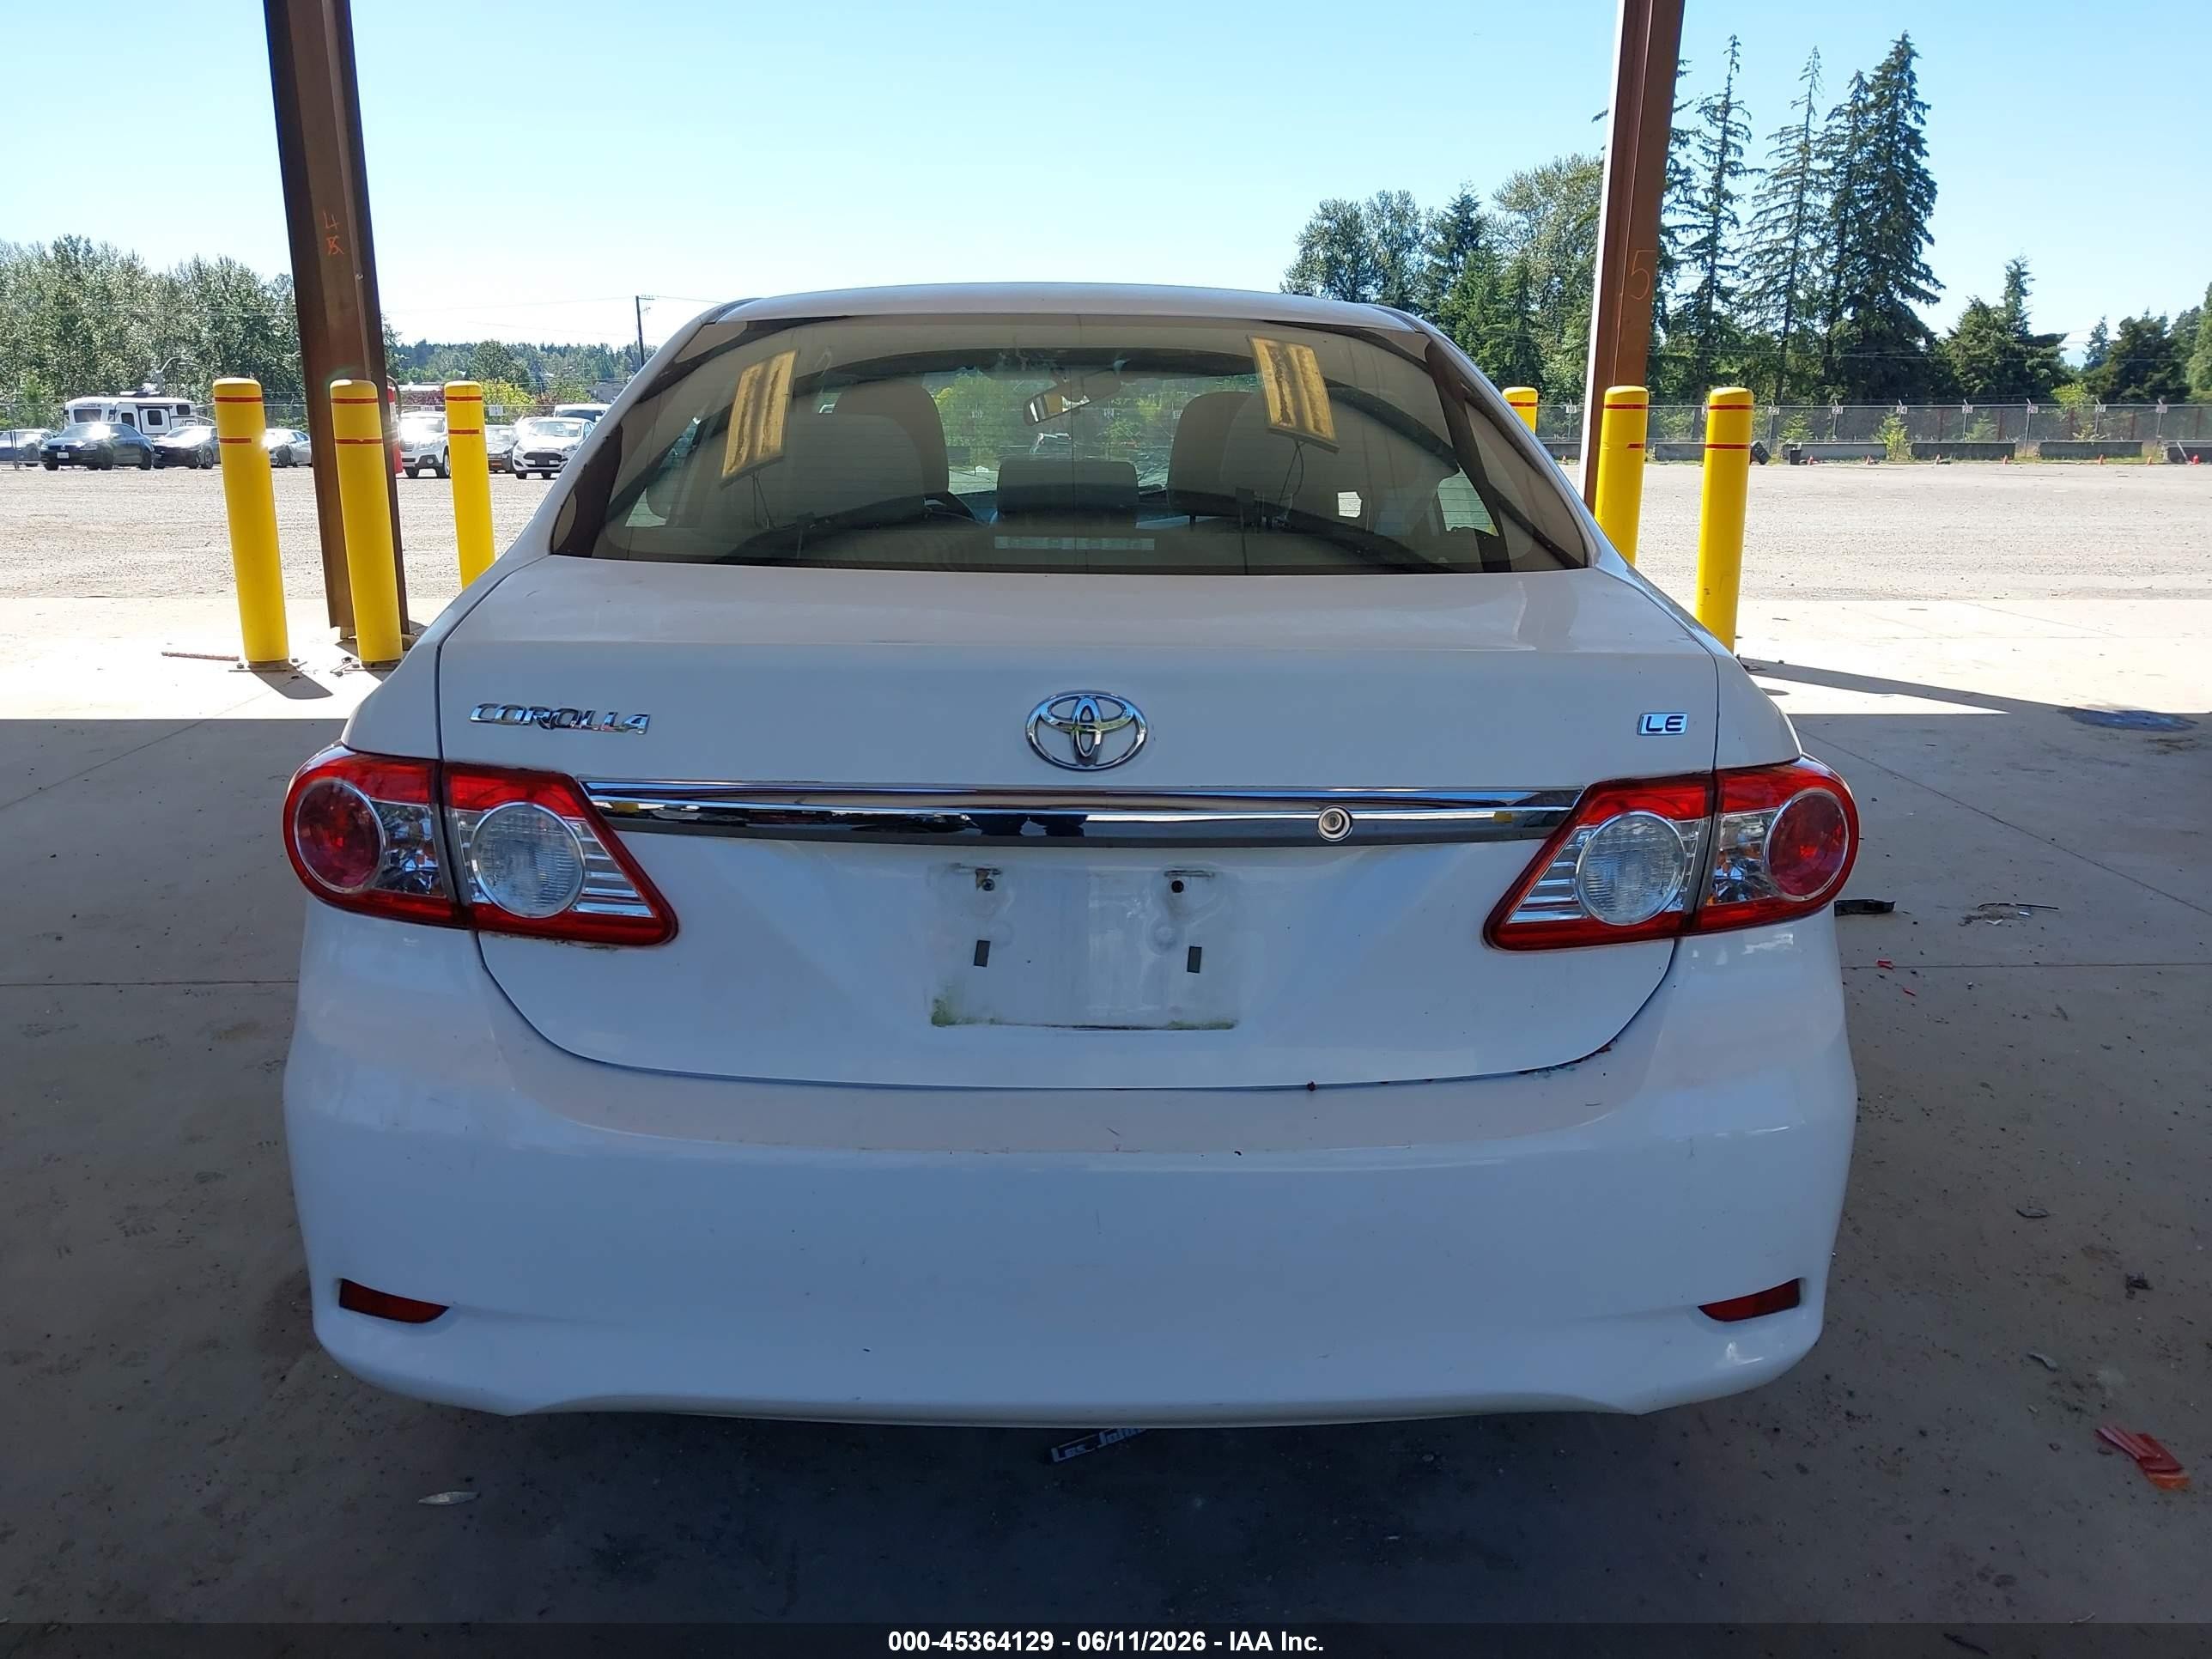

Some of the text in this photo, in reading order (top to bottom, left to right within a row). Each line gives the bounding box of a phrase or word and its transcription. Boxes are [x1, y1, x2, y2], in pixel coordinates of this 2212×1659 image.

[1631, 249, 1657, 301] 5
[470, 702, 652, 735] COROLLA
[1645, 715, 1685, 732] LE
